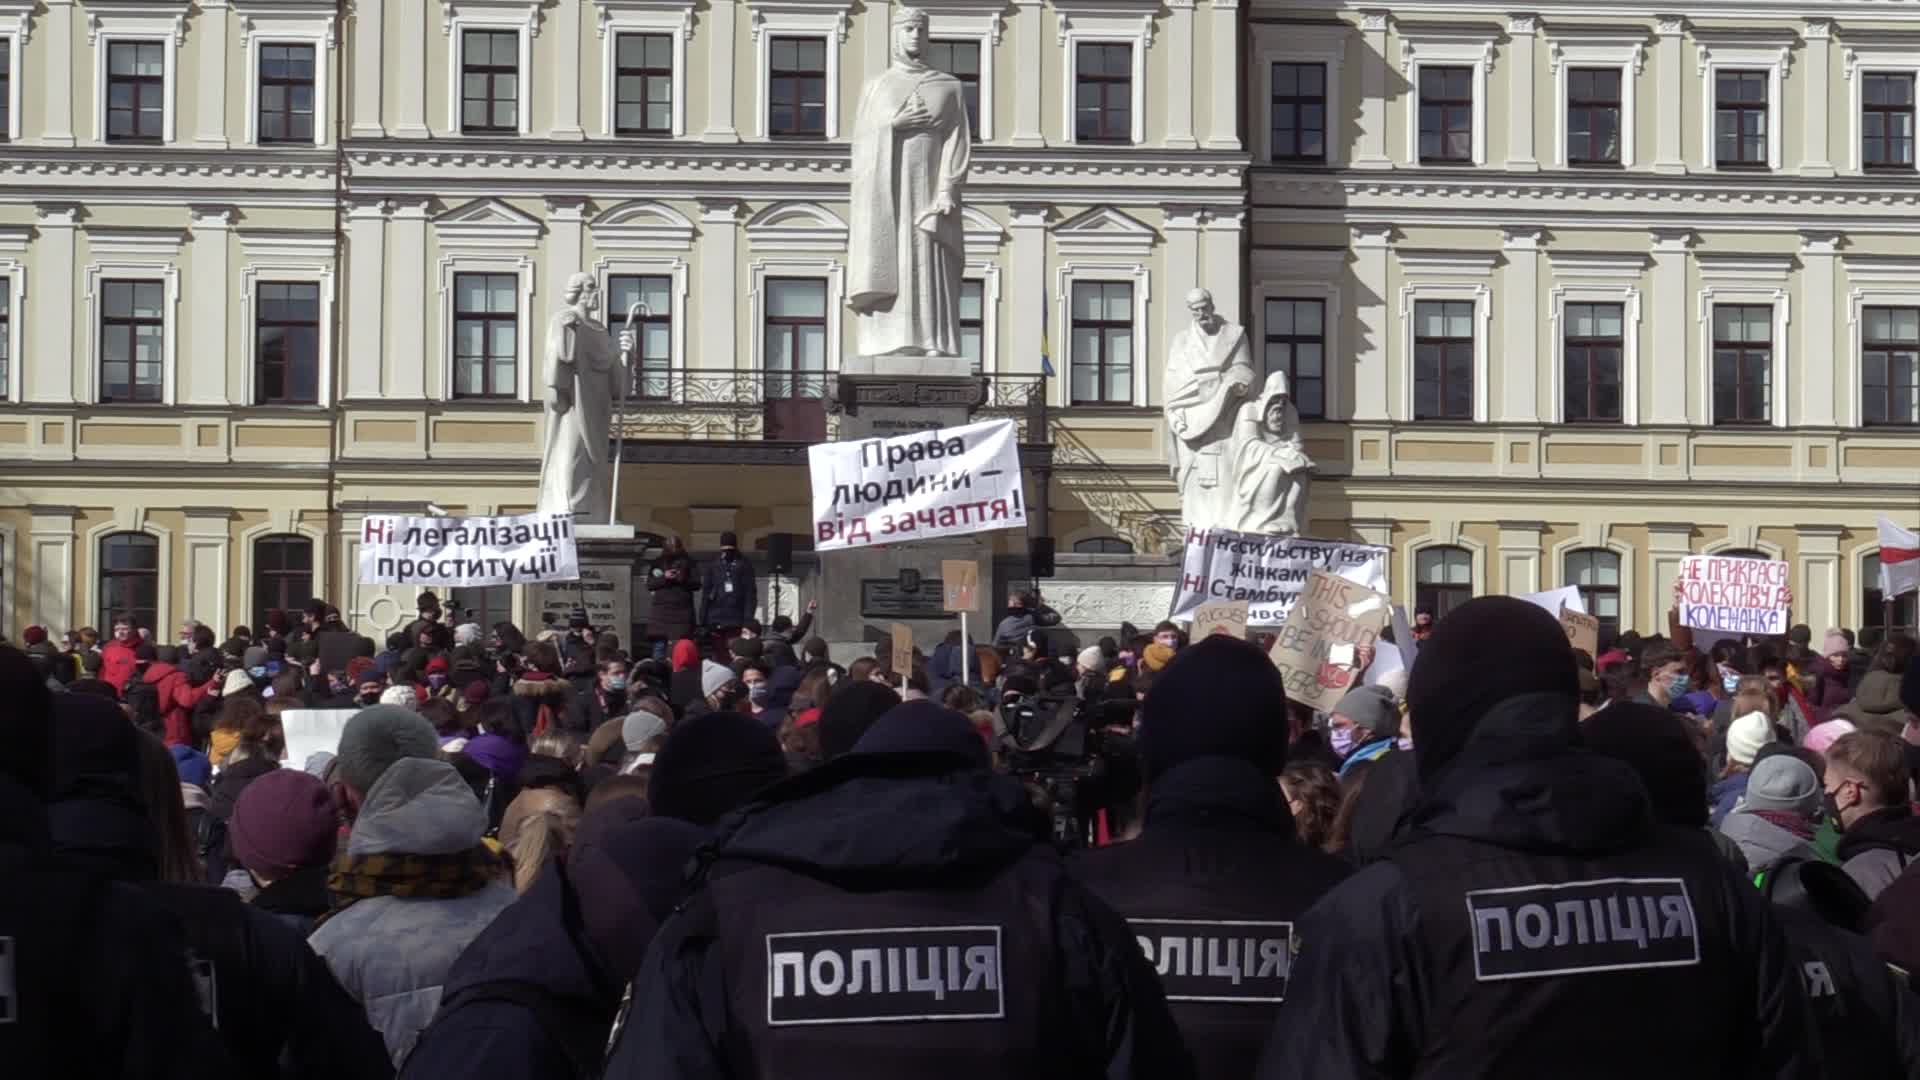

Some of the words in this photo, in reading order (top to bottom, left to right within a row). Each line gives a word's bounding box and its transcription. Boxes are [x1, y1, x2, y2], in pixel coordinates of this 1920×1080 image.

[861, 436, 965, 472] Права
[832, 469, 971, 506] людини
[364, 519, 393, 544] Ні
[402, 513, 569, 546] легалізації
[817, 513, 871, 545] від
[880, 489, 1022, 535] зачаття!
[377, 547, 557, 583] проституції
[1216, 535, 1334, 565] насильству
[1229, 561, 1308, 583] жінкам
[1682, 559, 1702, 581] НЕ
[1708, 559, 1787, 586] ПРИКРАСА
[1312, 573, 1352, 609] THIS
[1474, 894, 1694, 952] ПОЛІЦІЯ
[773, 946, 998, 1000] ПОЛІЦІЯ
[1135, 935, 1289, 985] ЛІЦІЯ
